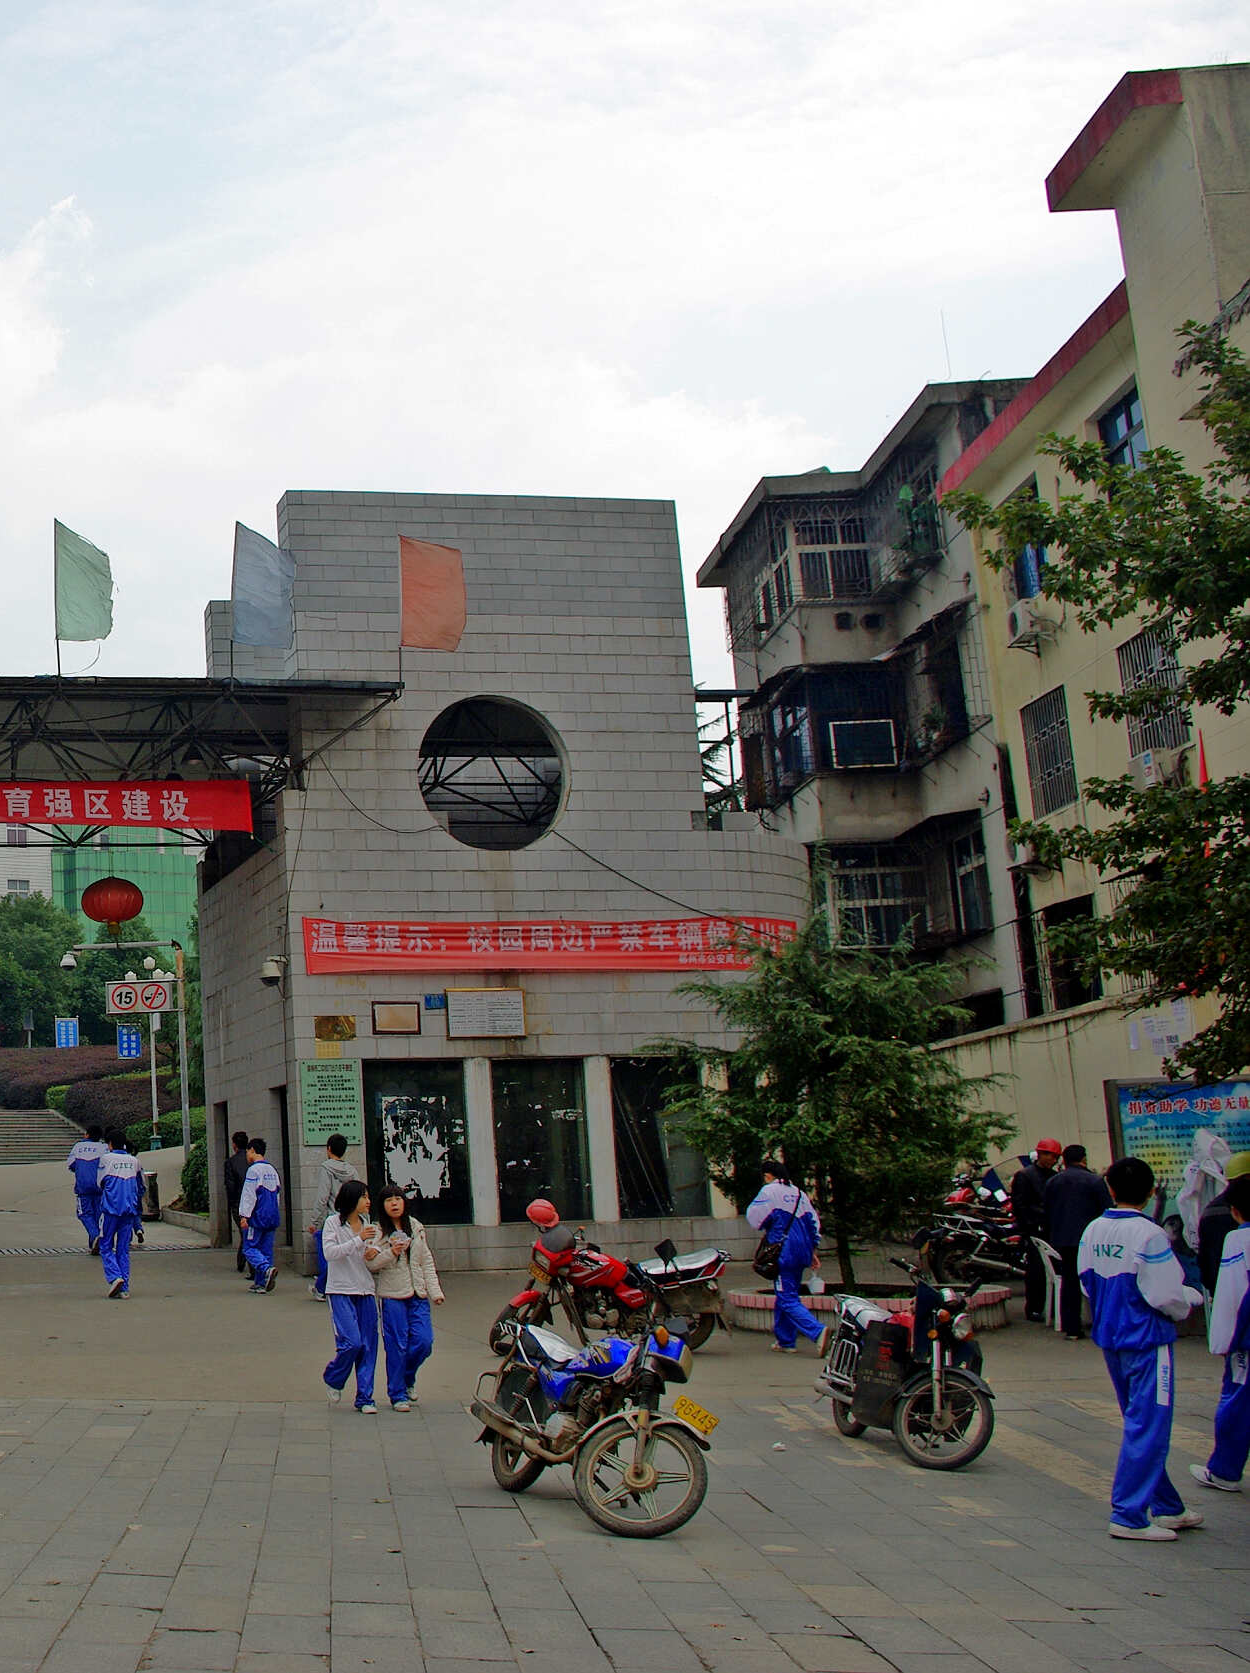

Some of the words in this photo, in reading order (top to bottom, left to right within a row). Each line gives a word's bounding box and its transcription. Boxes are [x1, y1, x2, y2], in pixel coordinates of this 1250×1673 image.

[116, 991, 133, 1005] 15
[1127, 1098, 1189, 1115] 捐资助学
